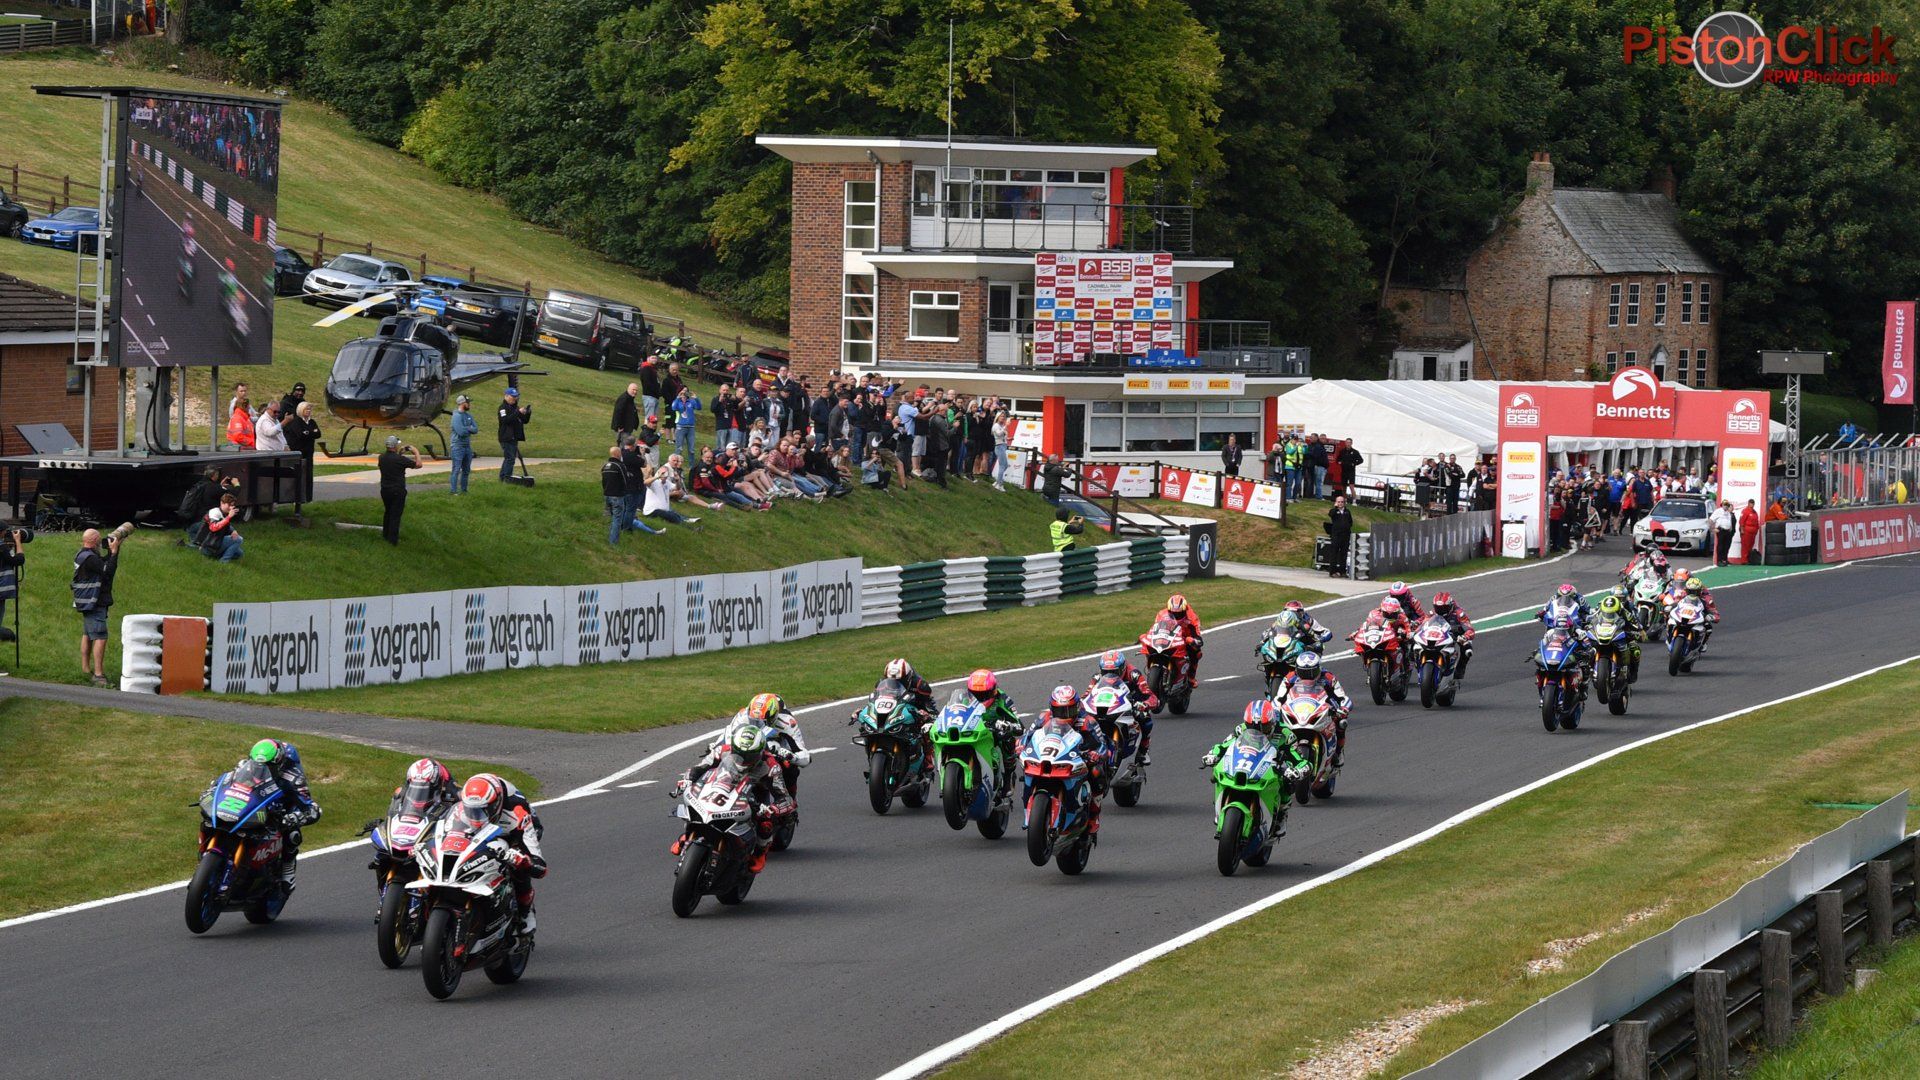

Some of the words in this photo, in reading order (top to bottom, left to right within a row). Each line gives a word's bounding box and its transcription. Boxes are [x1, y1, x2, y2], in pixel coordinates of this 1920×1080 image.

[1101, 260, 1131, 273] BSB
[1507, 414, 1538, 424] BSB
[1596, 403, 1671, 419] Bennetts
[1728, 413, 1760, 421] Bennetts
[1728, 420, 1760, 430] BSB
[1792, 525, 1807, 544] ebay
[1842, 518, 1904, 549] OMOLOGATO
[708, 583, 764, 645] xograph
[802, 569, 853, 630] xograph
[489, 599, 555, 666] xograph
[604, 592, 666, 658] xograph
[251, 615, 319, 692] xograph
[370, 605, 441, 680] xograph
